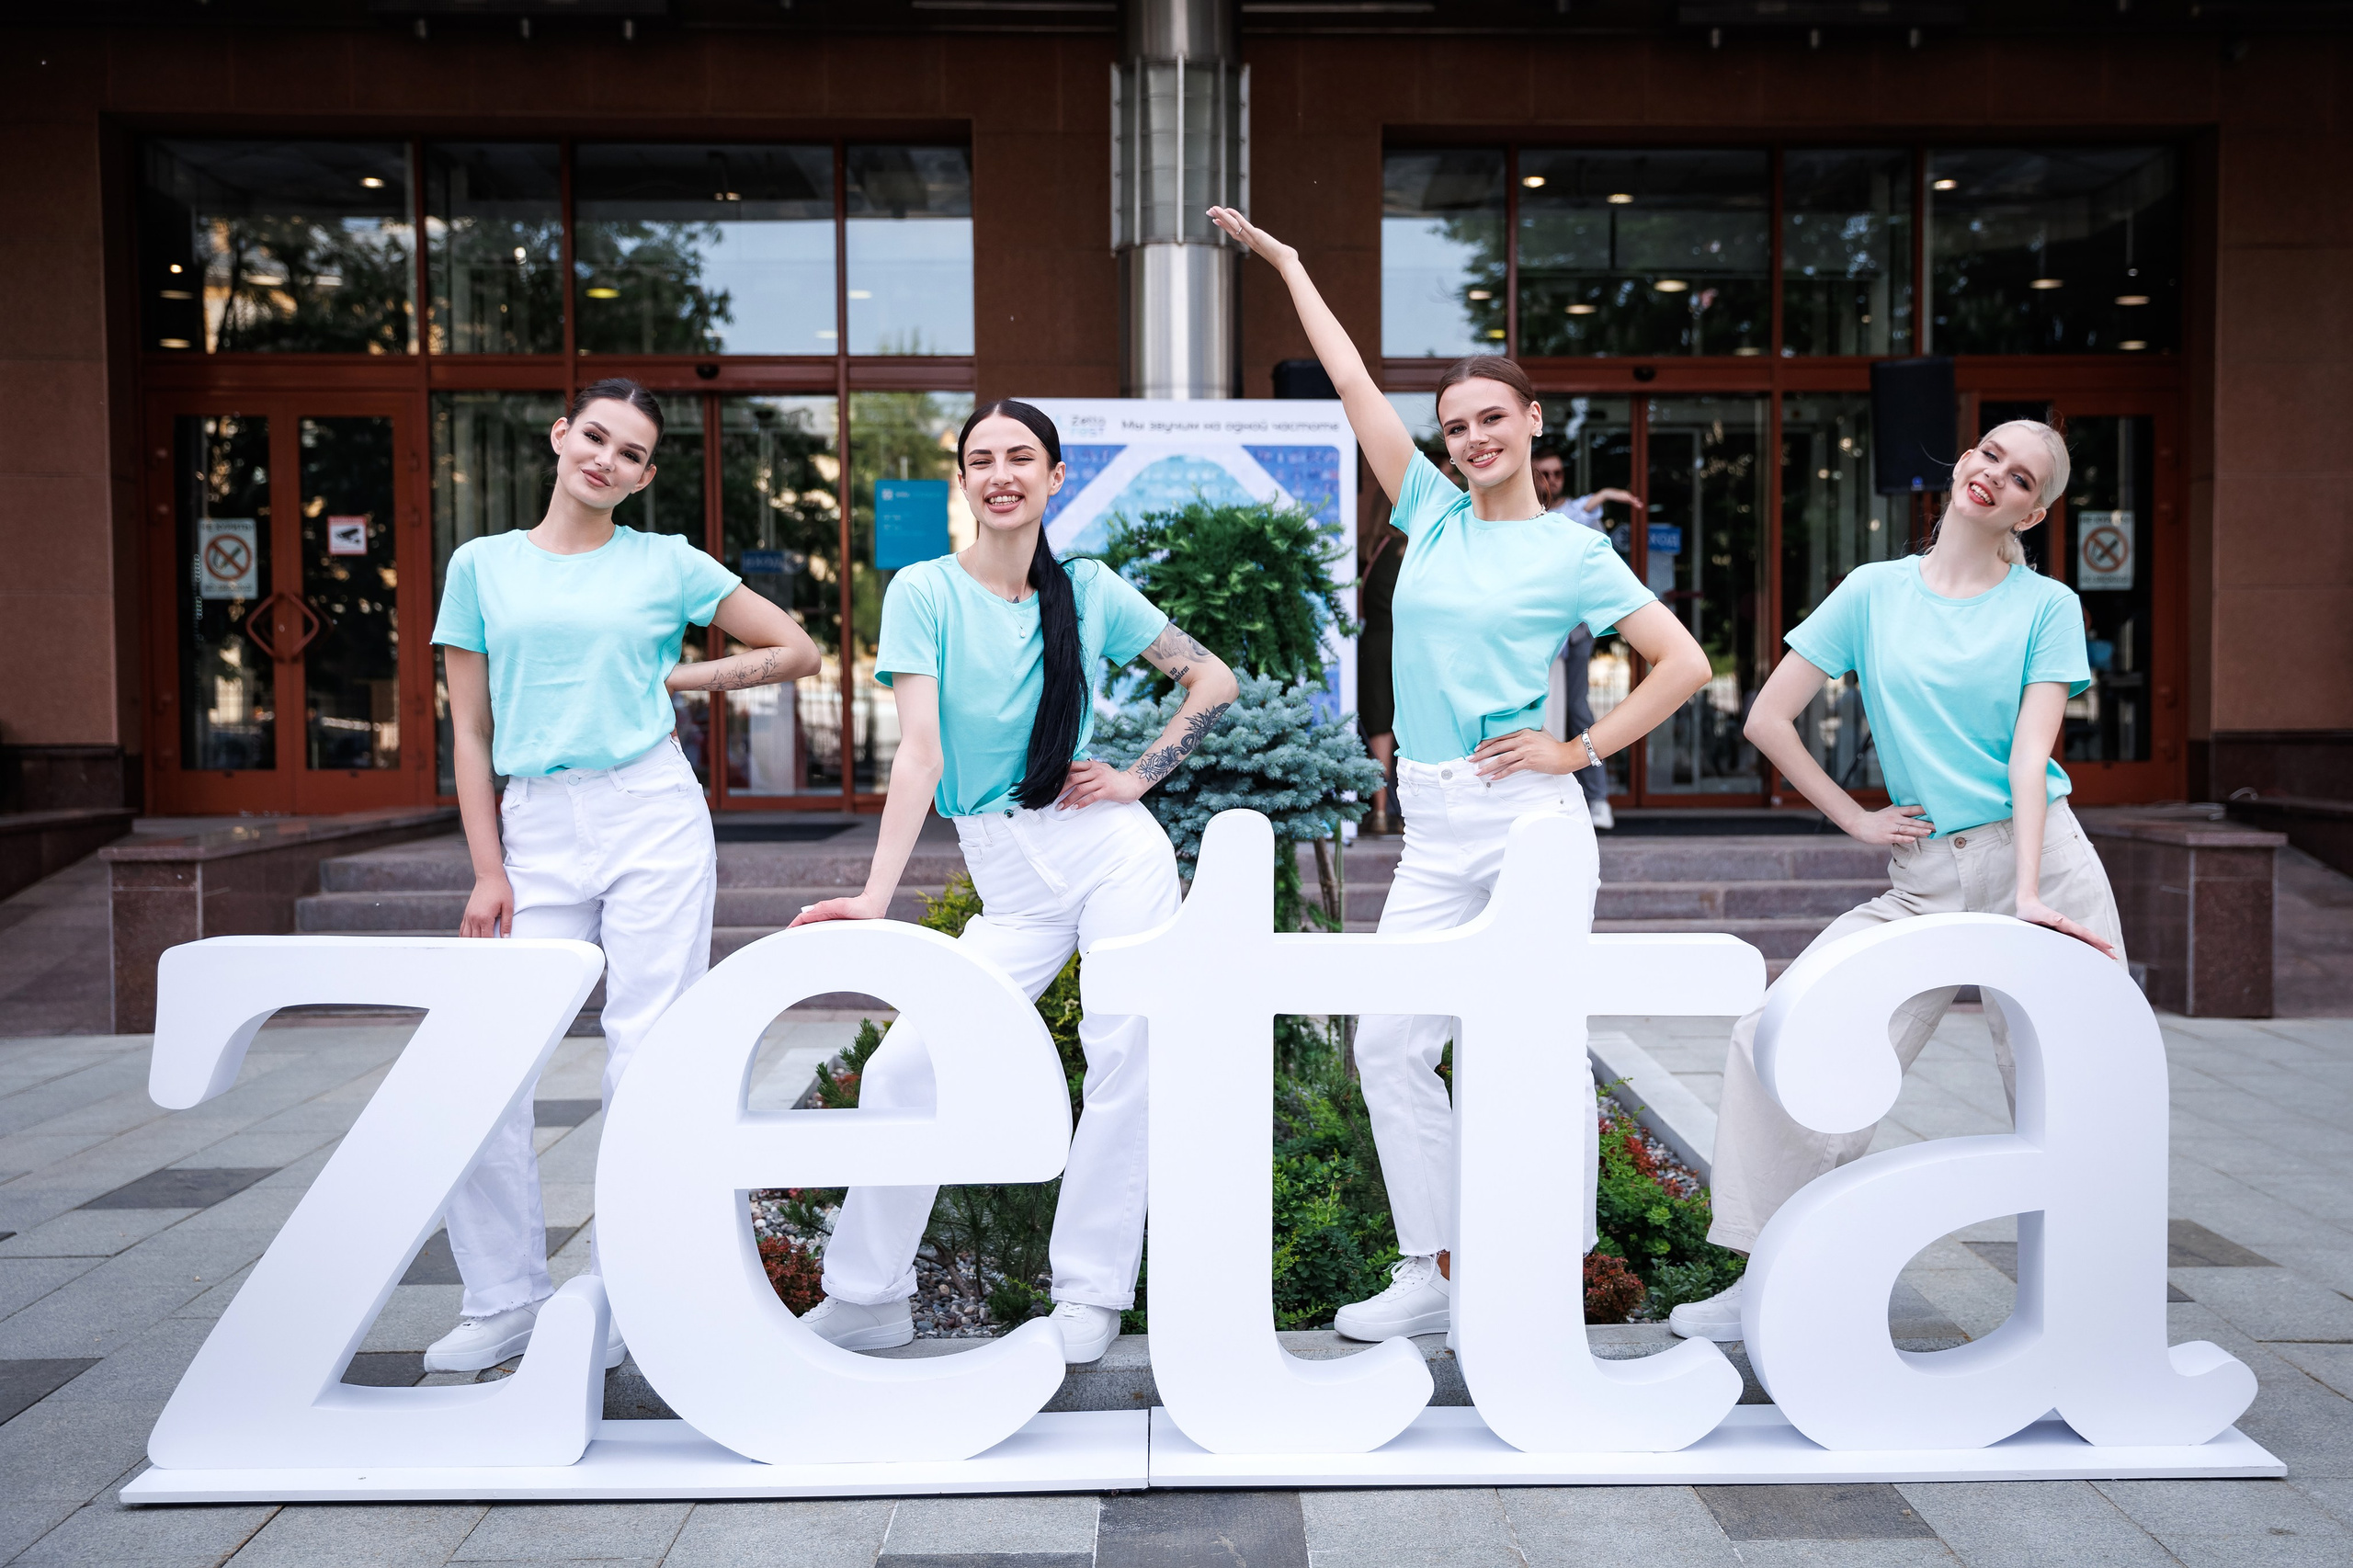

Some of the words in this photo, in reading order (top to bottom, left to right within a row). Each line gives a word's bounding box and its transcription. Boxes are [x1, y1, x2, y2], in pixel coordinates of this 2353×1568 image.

[1121, 420, 1145, 430] Мы
[1149, 421, 1199, 433] звучим
[1203, 422, 1222, 431] на
[1224, 419, 1267, 433] одной
[1271, 422, 1339, 431] частоте
[147, 810, 2258, 1471] zetta
